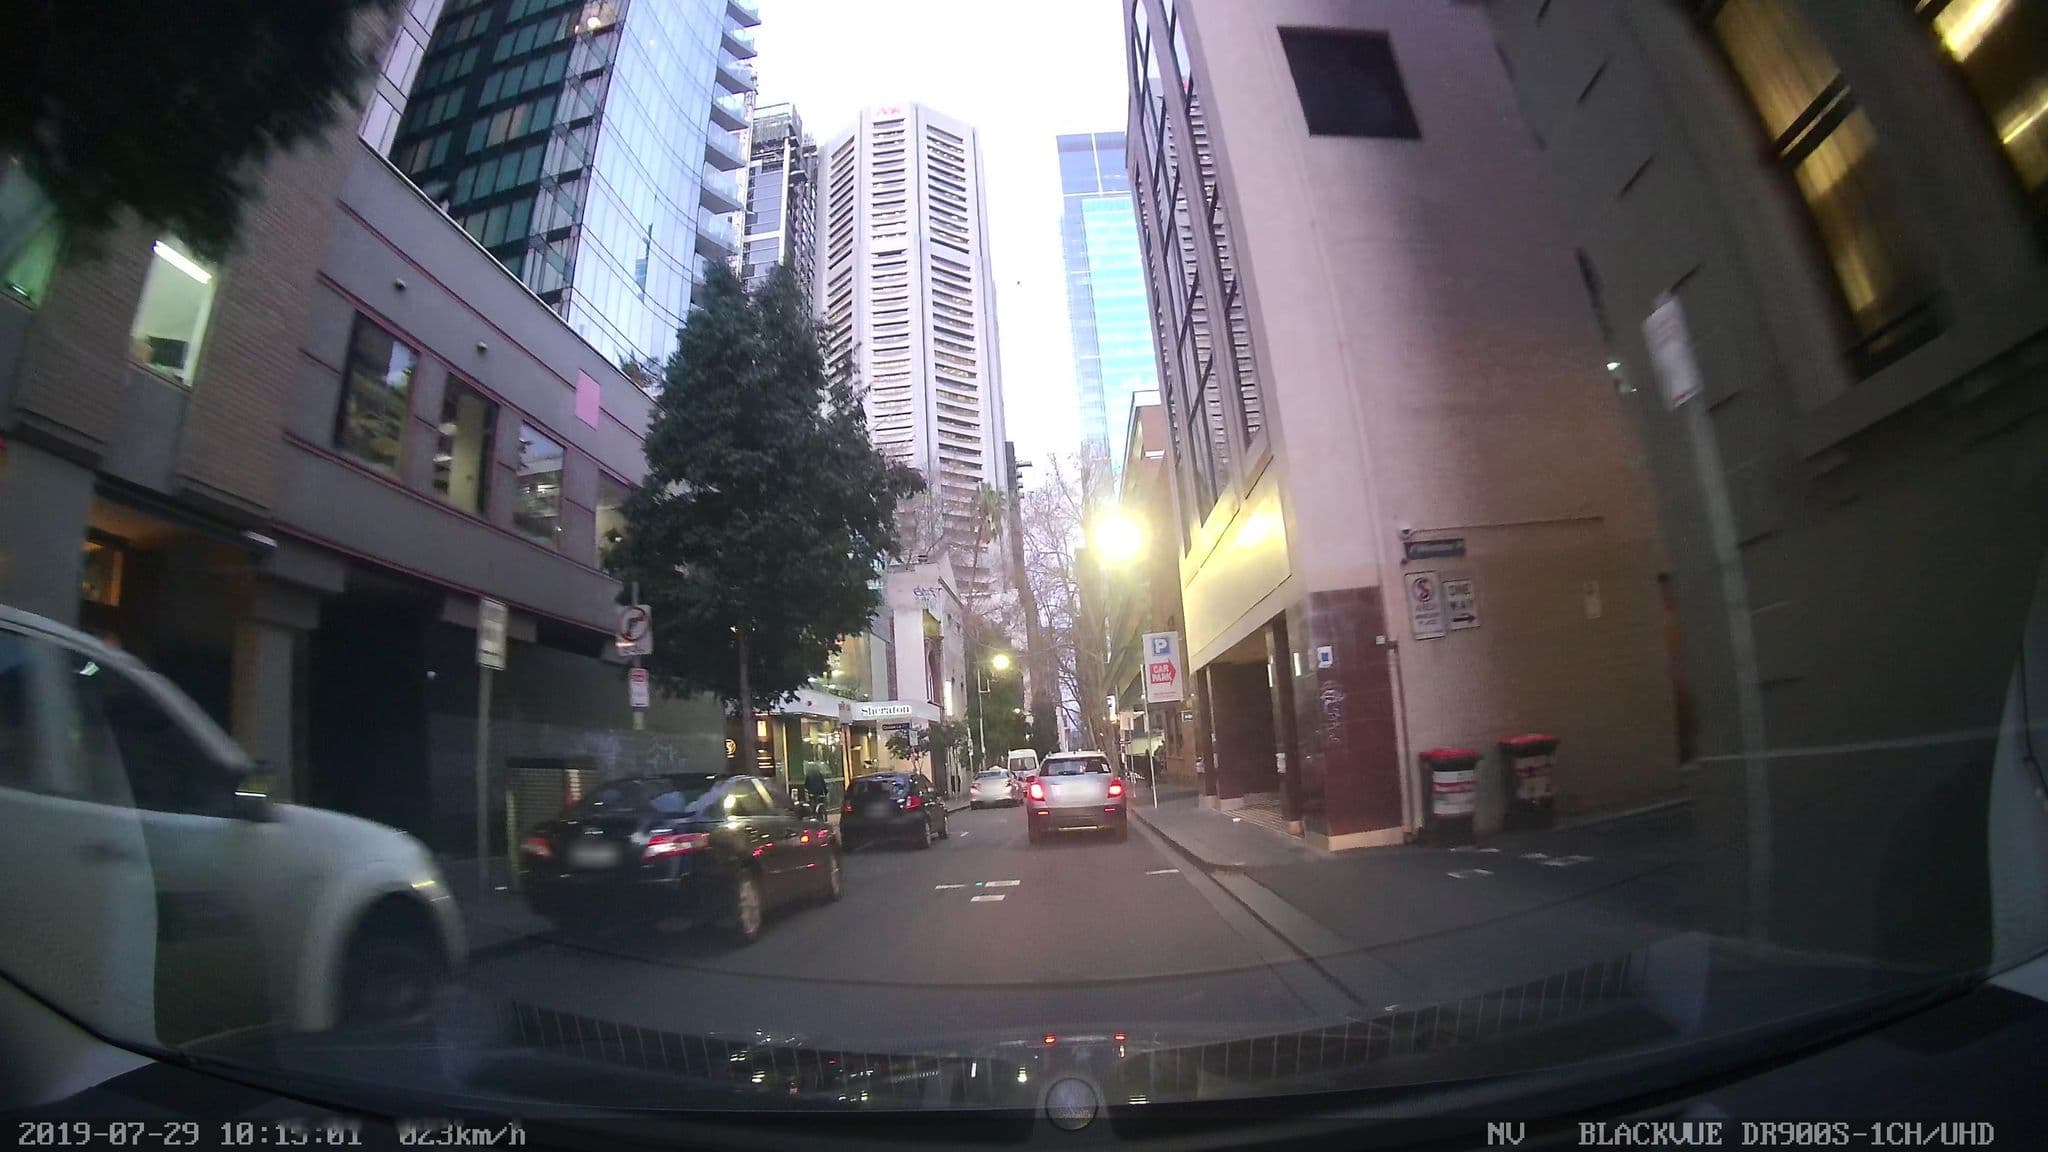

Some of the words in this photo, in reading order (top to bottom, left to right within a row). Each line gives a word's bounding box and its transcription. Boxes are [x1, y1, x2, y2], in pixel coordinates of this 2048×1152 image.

[1154, 638, 1168, 654] P
[1152, 664, 1169, 675] CAR
[1151, 672, 1173, 683] PARK
[861, 705, 910, 717] Sheraton
